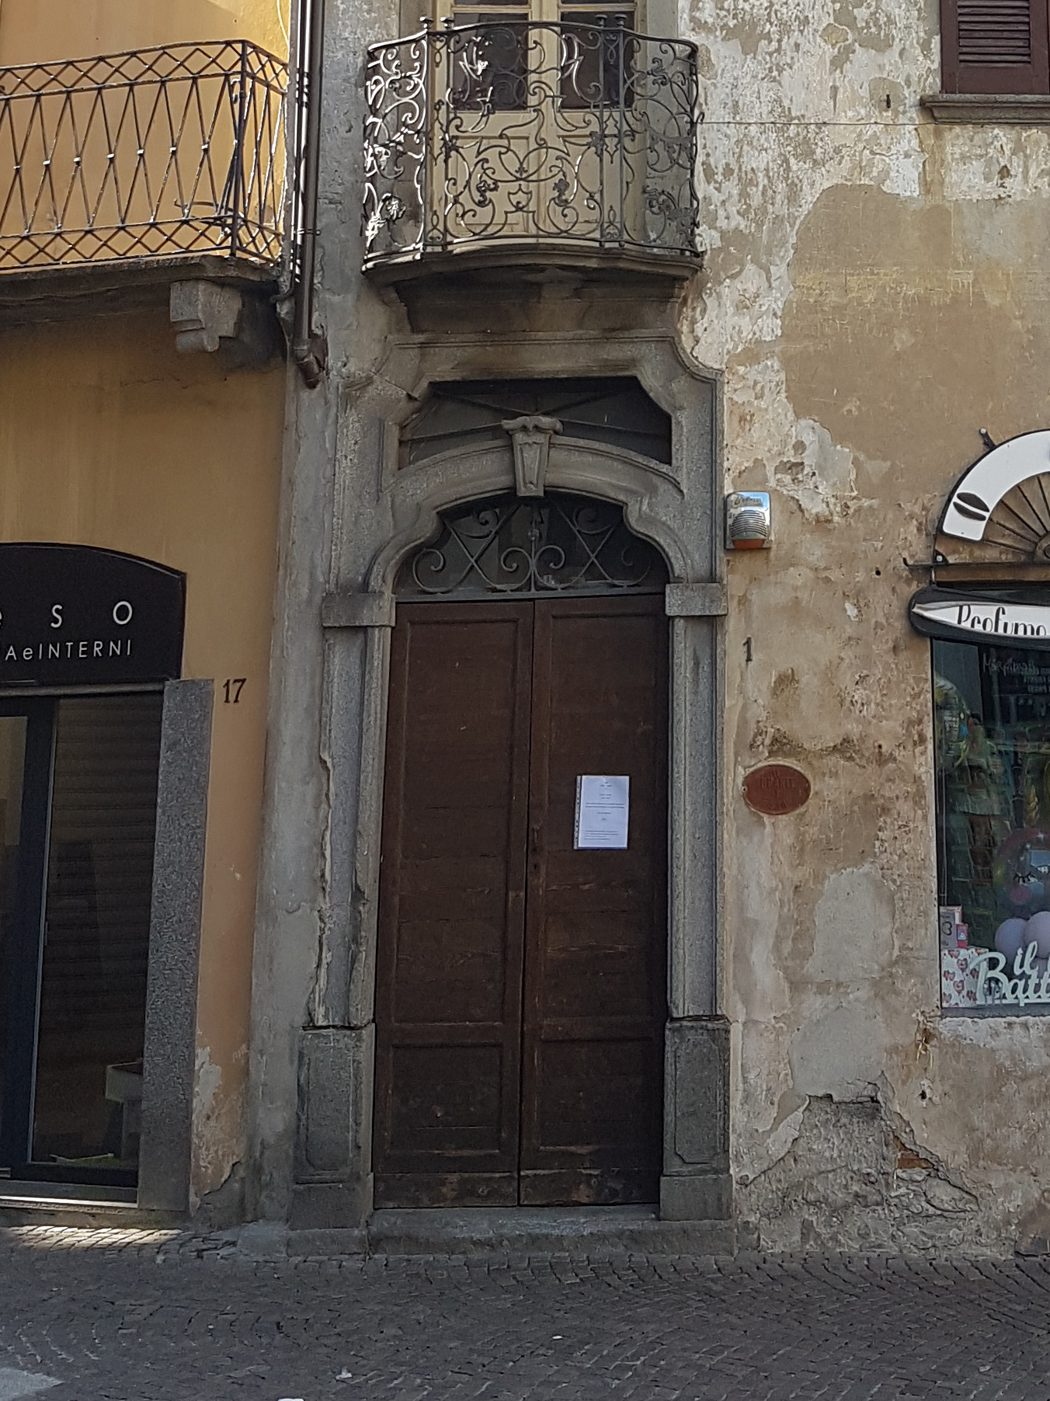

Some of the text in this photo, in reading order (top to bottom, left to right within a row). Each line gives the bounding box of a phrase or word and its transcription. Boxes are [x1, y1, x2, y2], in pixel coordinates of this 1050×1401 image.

[0, 601, 133, 628] SO
[743, 636, 752, 662] 1
[223, 678, 247, 704] 17
[1013, 941, 1038, 976] il
